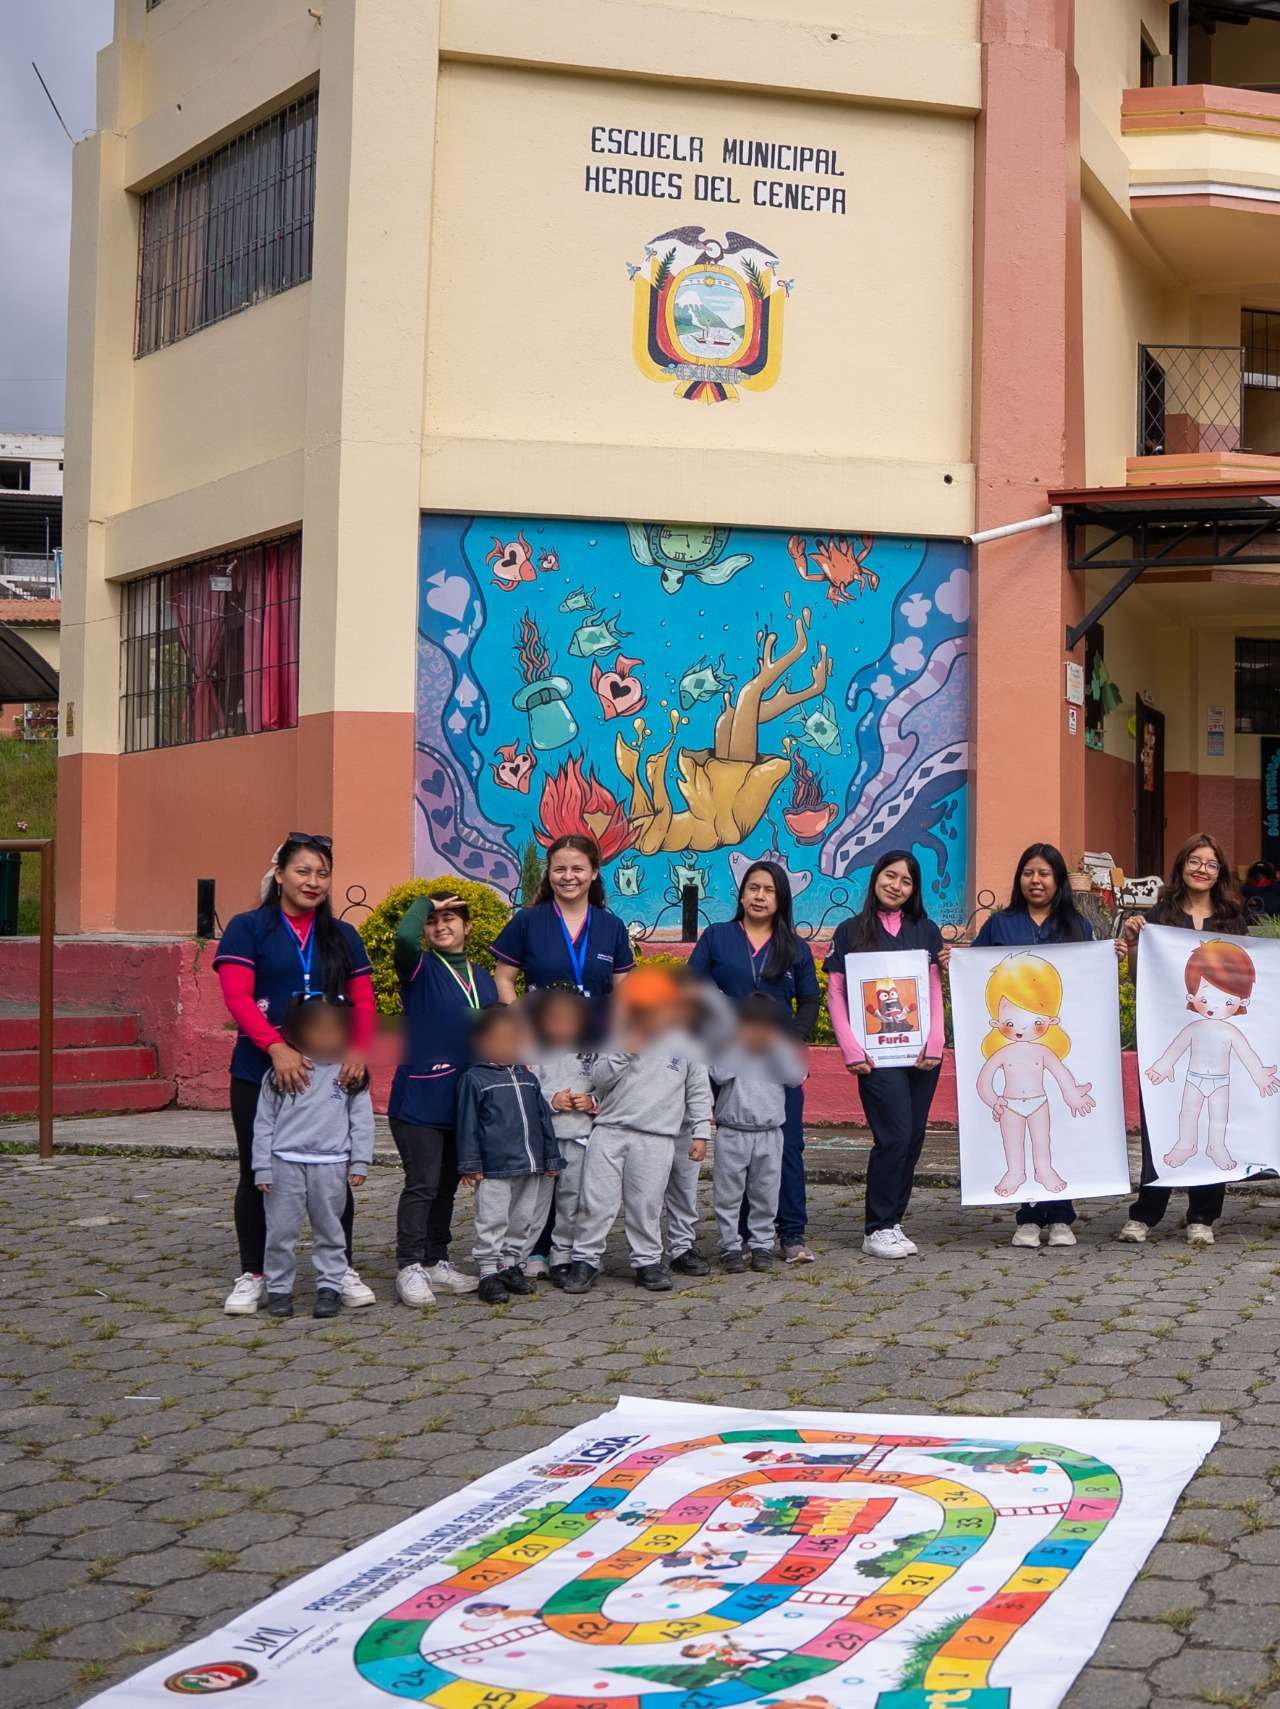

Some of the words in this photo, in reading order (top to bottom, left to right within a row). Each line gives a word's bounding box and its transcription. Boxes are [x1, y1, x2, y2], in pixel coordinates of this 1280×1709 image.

[591, 126, 704, 163] ESCUELA
[722, 137, 845, 177] MUNICIPAL
[585, 165, 683, 200] HEROES
[694, 174, 741, 204] DEL
[753, 180, 847, 214] CENEPA
[568, 1435, 641, 1463] LOJA
[637, 1453, 664, 1465] 16
[611, 1473, 637, 1483] 17
[794, 1468, 824, 1481] 36
[872, 1474, 902, 1483] 35
[718, 1479, 748, 1490] 37
[584, 1495, 616, 1507] 18
[944, 1491, 969, 1502] 34
[679, 1504, 708, 1518] 38
[1079, 1503, 1105, 1511] 7
[554, 1518, 585, 1531] 19
[956, 1517, 983, 1528] 33
[644, 1534, 678, 1548] 39
[805, 1538, 839, 1552] 46
[512, 1543, 550, 1559] 20
[934, 1545, 967, 1556] 32
[1040, 1547, 1069, 1555] 5
[608, 1554, 644, 1571] 40
[471, 1569, 509, 1584] 21
[778, 1565, 816, 1581] 45
[901, 1574, 936, 1587] 31
[302, 1566, 396, 1611] PREVENCIÓN
[416, 1593, 456, 1610] 22
[736, 1593, 779, 1611] 44
[868, 1603, 904, 1618] 30
[569, 1621, 615, 1640] 42
[659, 1621, 701, 1640] 43
[232, 1626, 298, 1653] unl
[826, 1632, 864, 1650] 29
[964, 1635, 995, 1644] 2
[391, 1667, 432, 1688] 24
